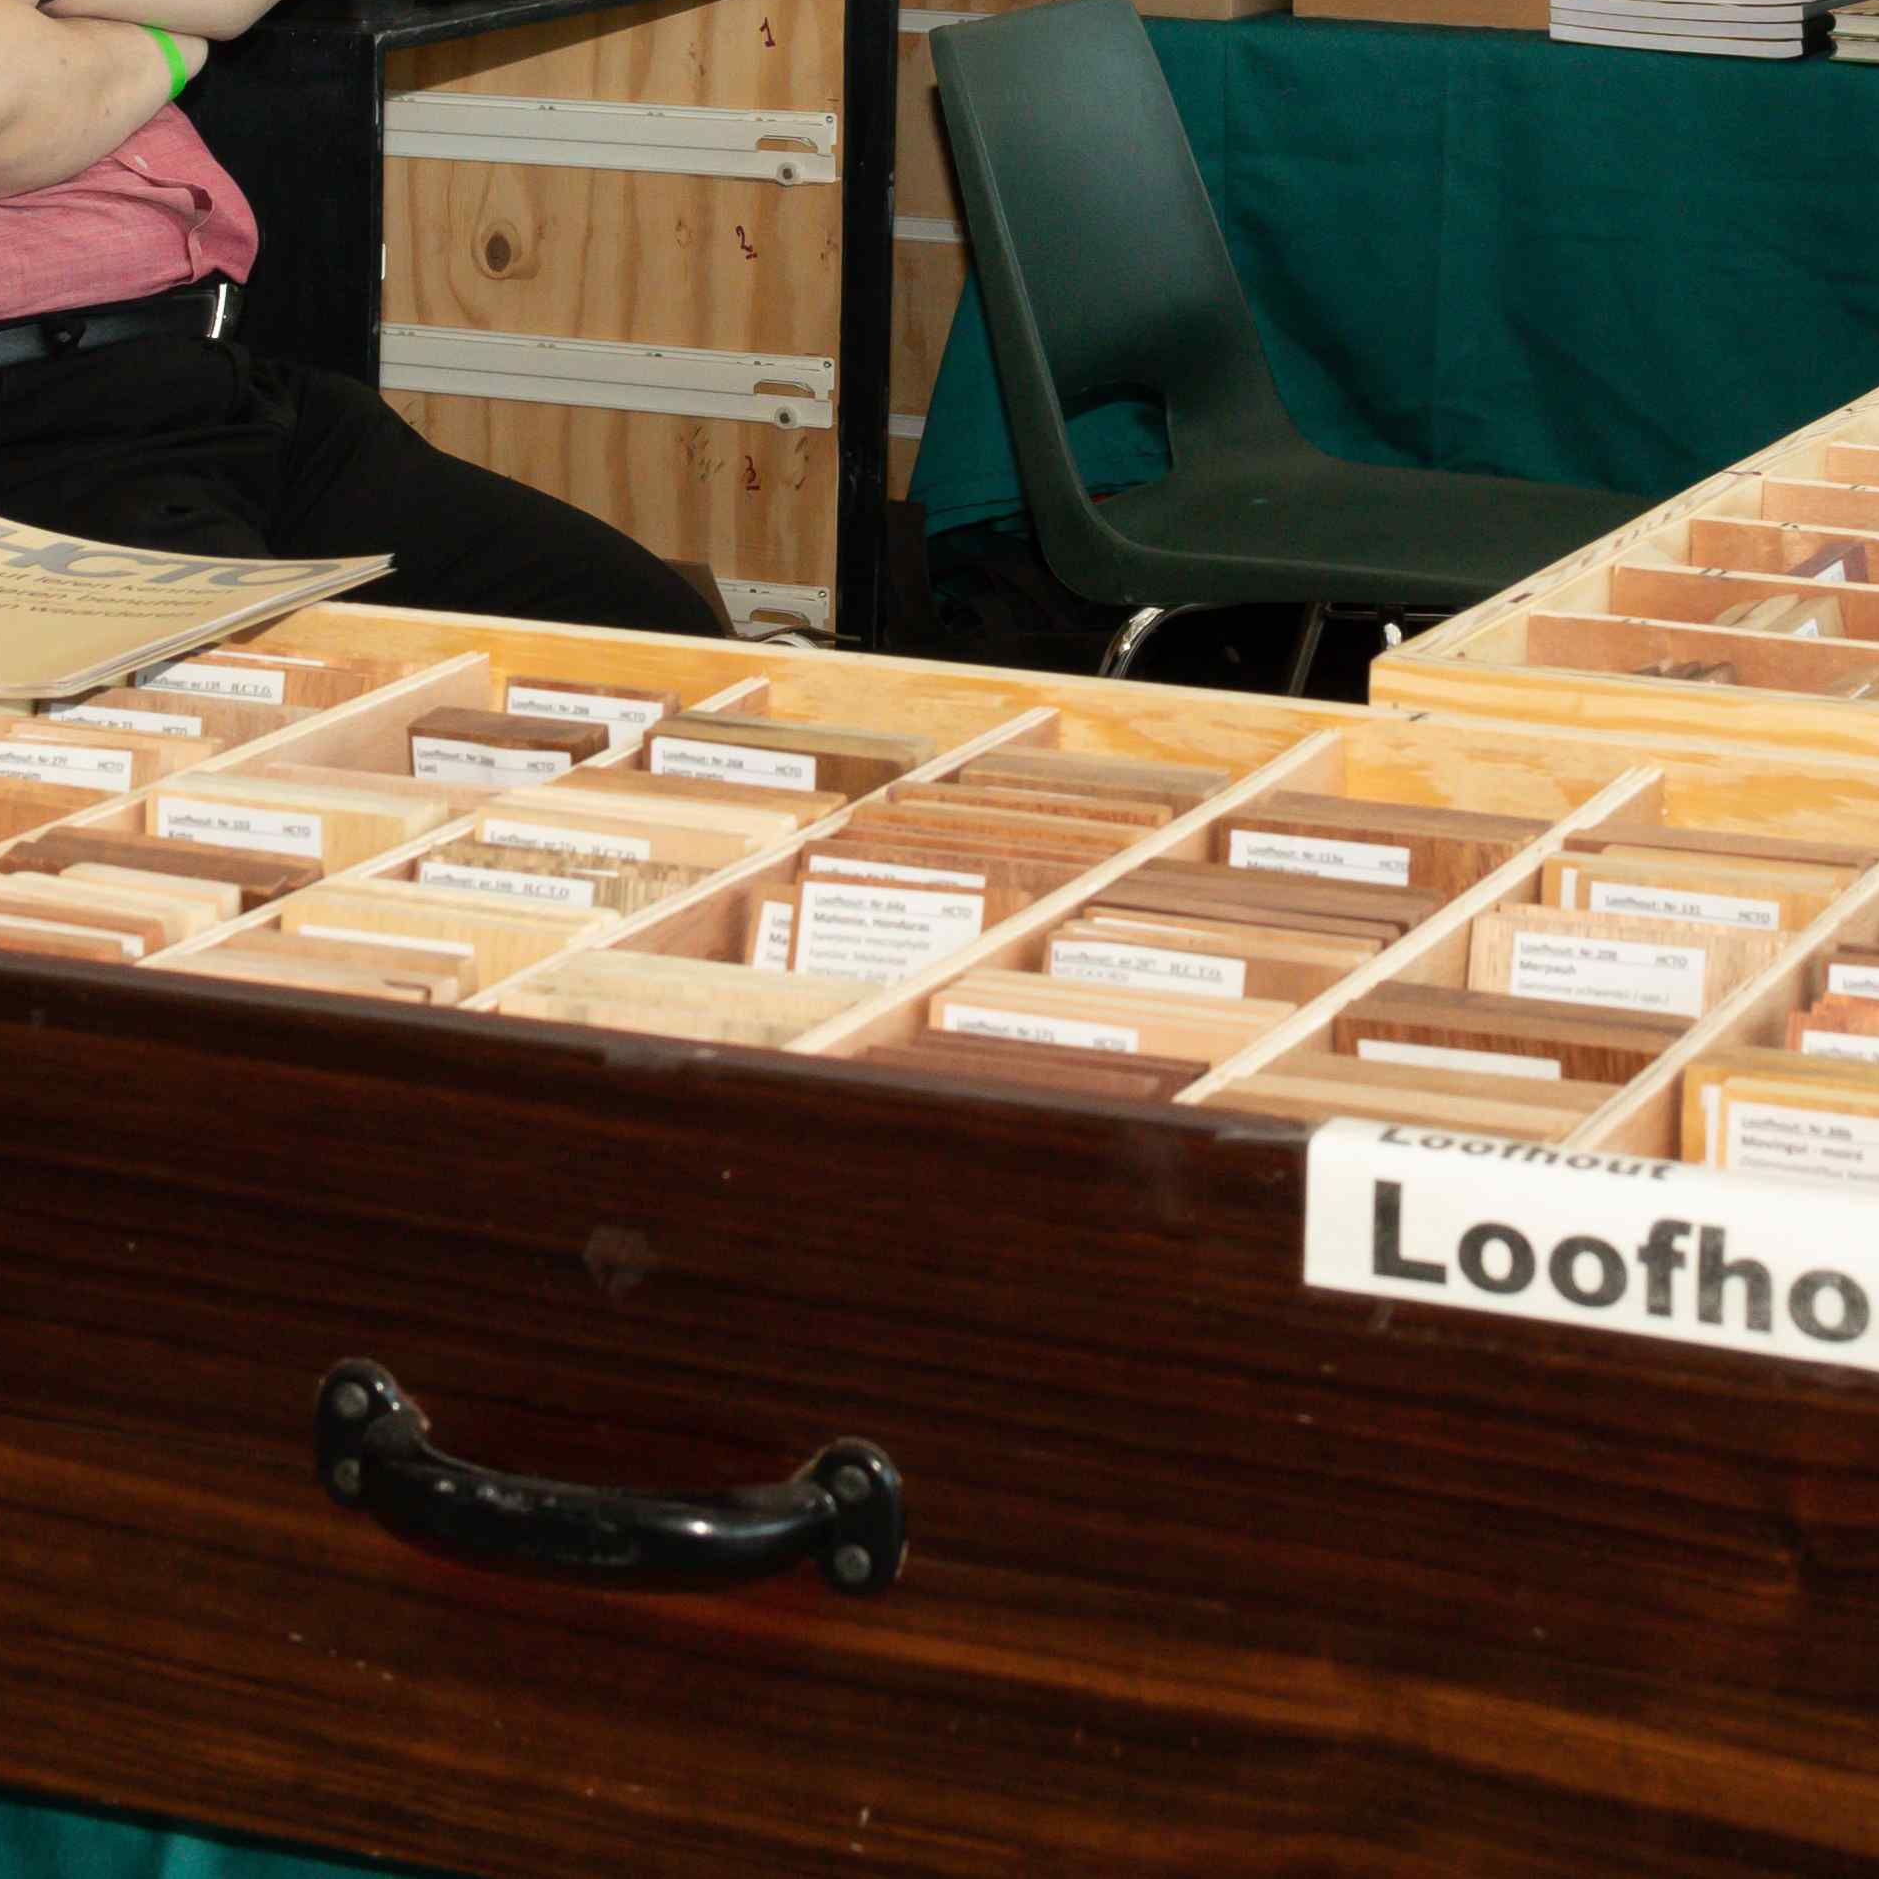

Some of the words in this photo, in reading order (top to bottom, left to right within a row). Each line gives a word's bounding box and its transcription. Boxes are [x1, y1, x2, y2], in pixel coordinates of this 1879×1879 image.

[34, 576, 113, 590] leren
[512, 699, 554, 713] Loofhout:
[620, 710, 646, 721] HCTO
[97, 760, 125, 773] HCTO
[417, 748, 464, 762] Loofhout:
[526, 761, 554, 772] HCTO
[662, 751, 709, 766] Loofhout:
[774, 764, 802, 778] HCTO
[167, 812, 215, 826] Loofhout:
[282, 824, 312, 838] HCTO
[1247, 844, 1299, 861] Loofhout:
[813, 892, 865, 909] Loofhout:
[941, 905, 973, 919] HCTO
[1605, 895, 1661, 912] Loofhout:
[1737, 911, 1771, 924] HCTO
[1520, 942, 1575, 959] Loofhout:
[1654, 956, 1688, 970] HCTO
[1741, 1115, 1802, 1133] Loofhout:
[1377, 1124, 1677, 1182] Loofhout
